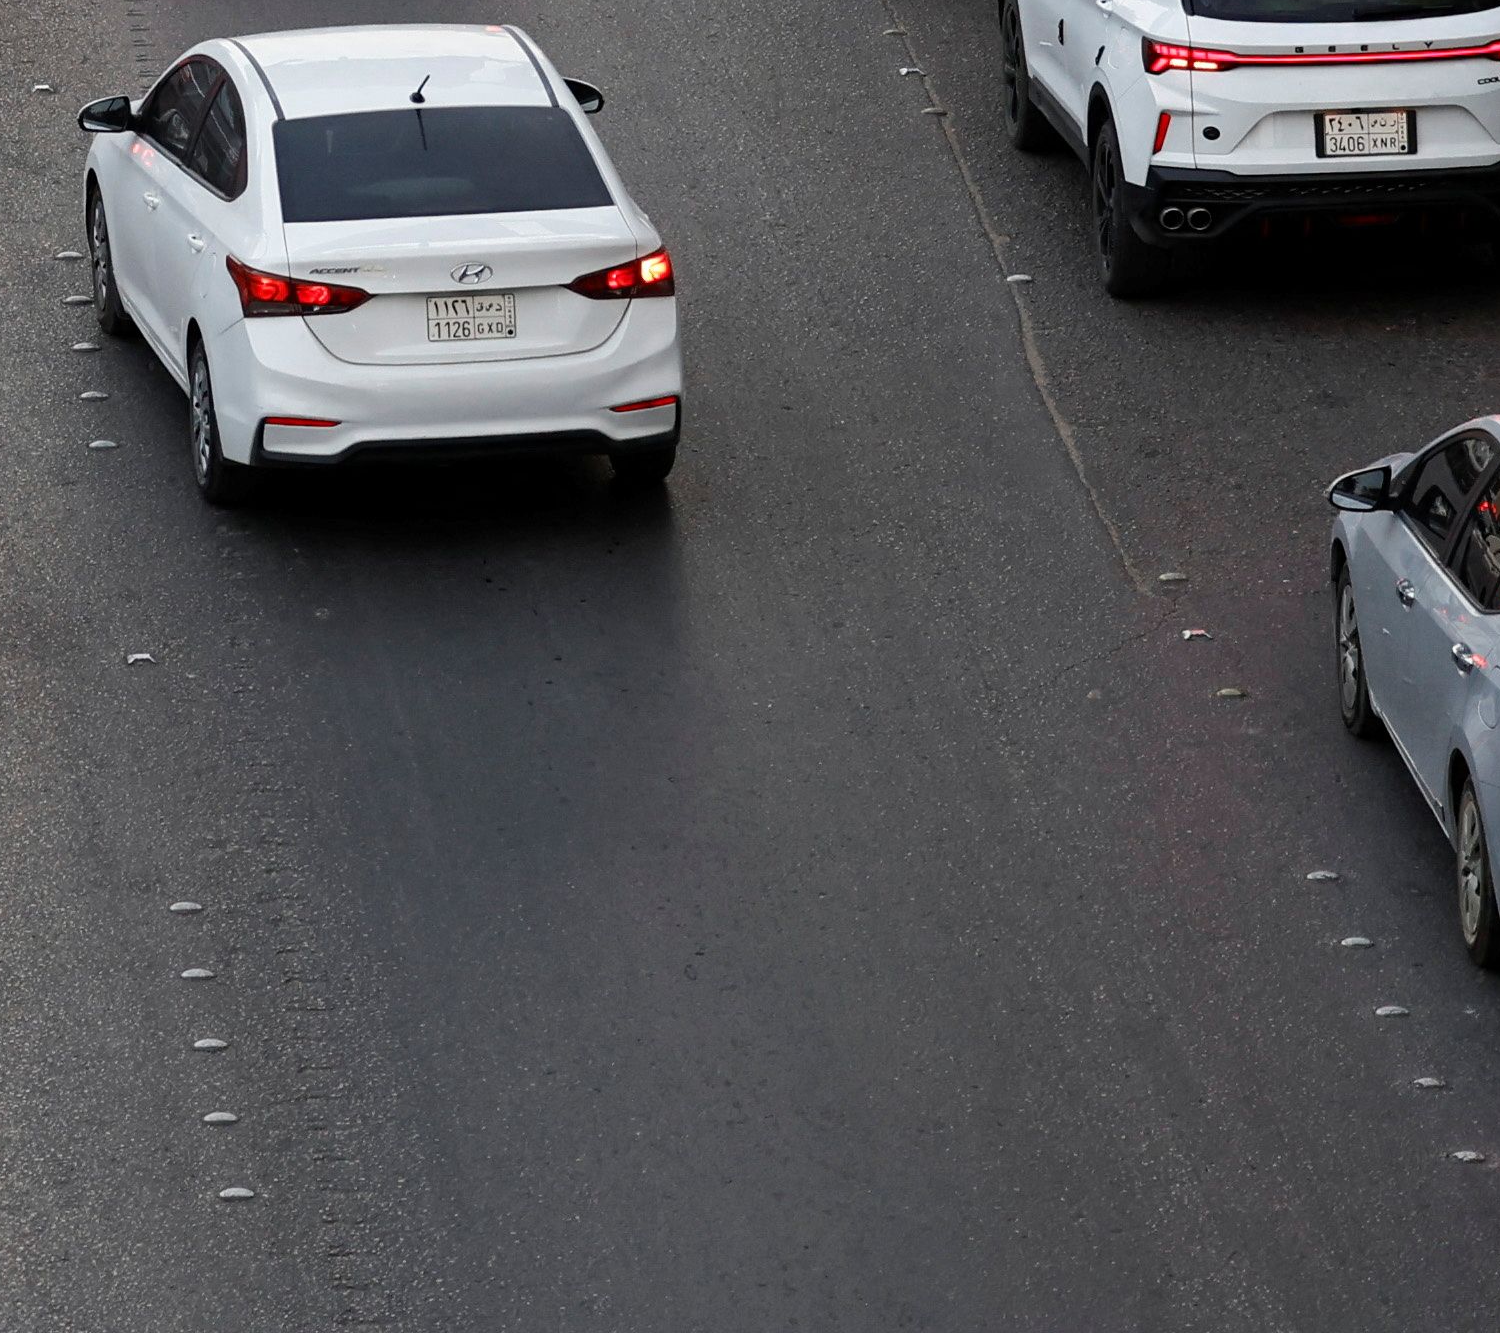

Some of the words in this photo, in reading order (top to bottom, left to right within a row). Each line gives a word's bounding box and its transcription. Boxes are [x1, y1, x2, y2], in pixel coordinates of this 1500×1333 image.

[1294, 41, 1433, 54] GEELY
[1328, 116, 1364, 133] ٣٤٠٦
[1329, 135, 1366, 153] 3406
[1371, 137, 1397, 149] XNR
[309, 266, 361, 276] ACCENT
[434, 299, 471, 316] ١١٢٦
[434, 321, 472, 338] 1126
[477, 322, 504, 334] GXD
